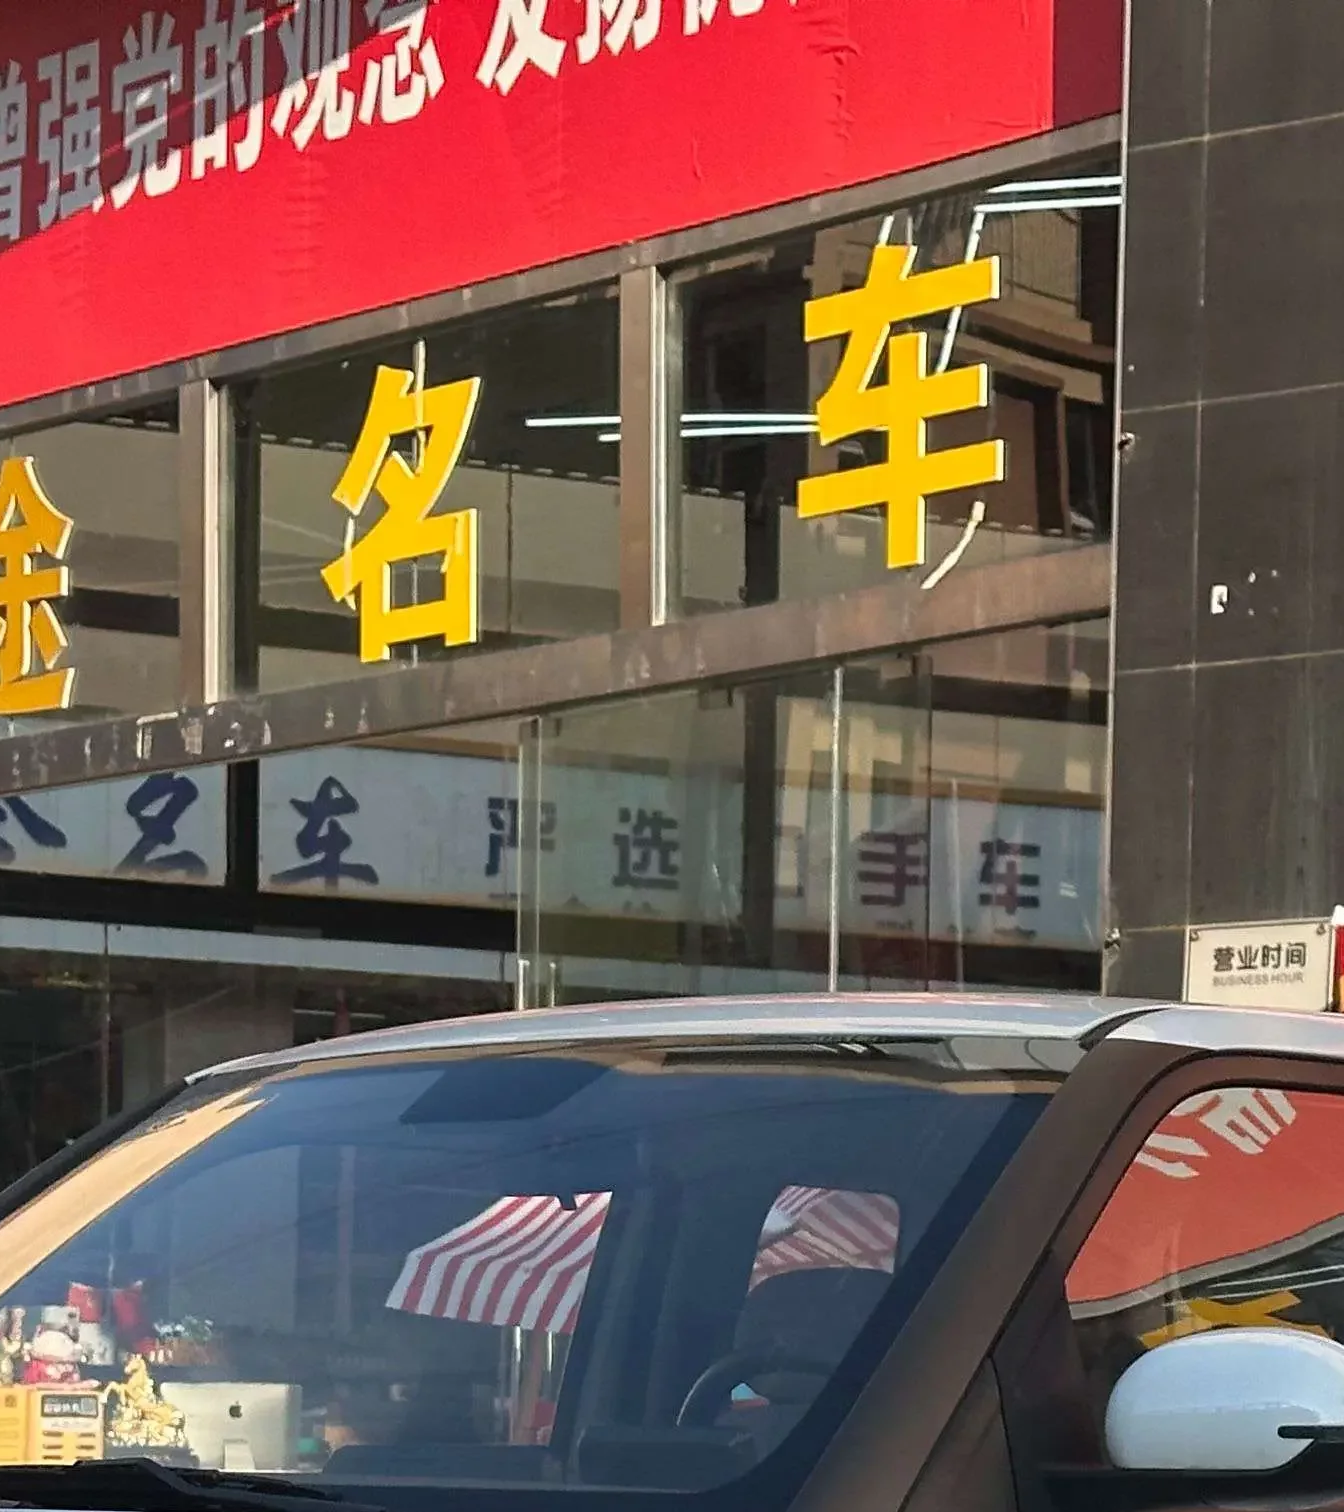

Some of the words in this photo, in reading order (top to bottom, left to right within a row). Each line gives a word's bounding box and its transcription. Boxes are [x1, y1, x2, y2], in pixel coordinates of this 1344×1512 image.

[1213, 942, 1307, 972] 营业时间
[1212, 973, 1268, 987] BUSINESS
[1270, 971, 1304, 985] HOUR
